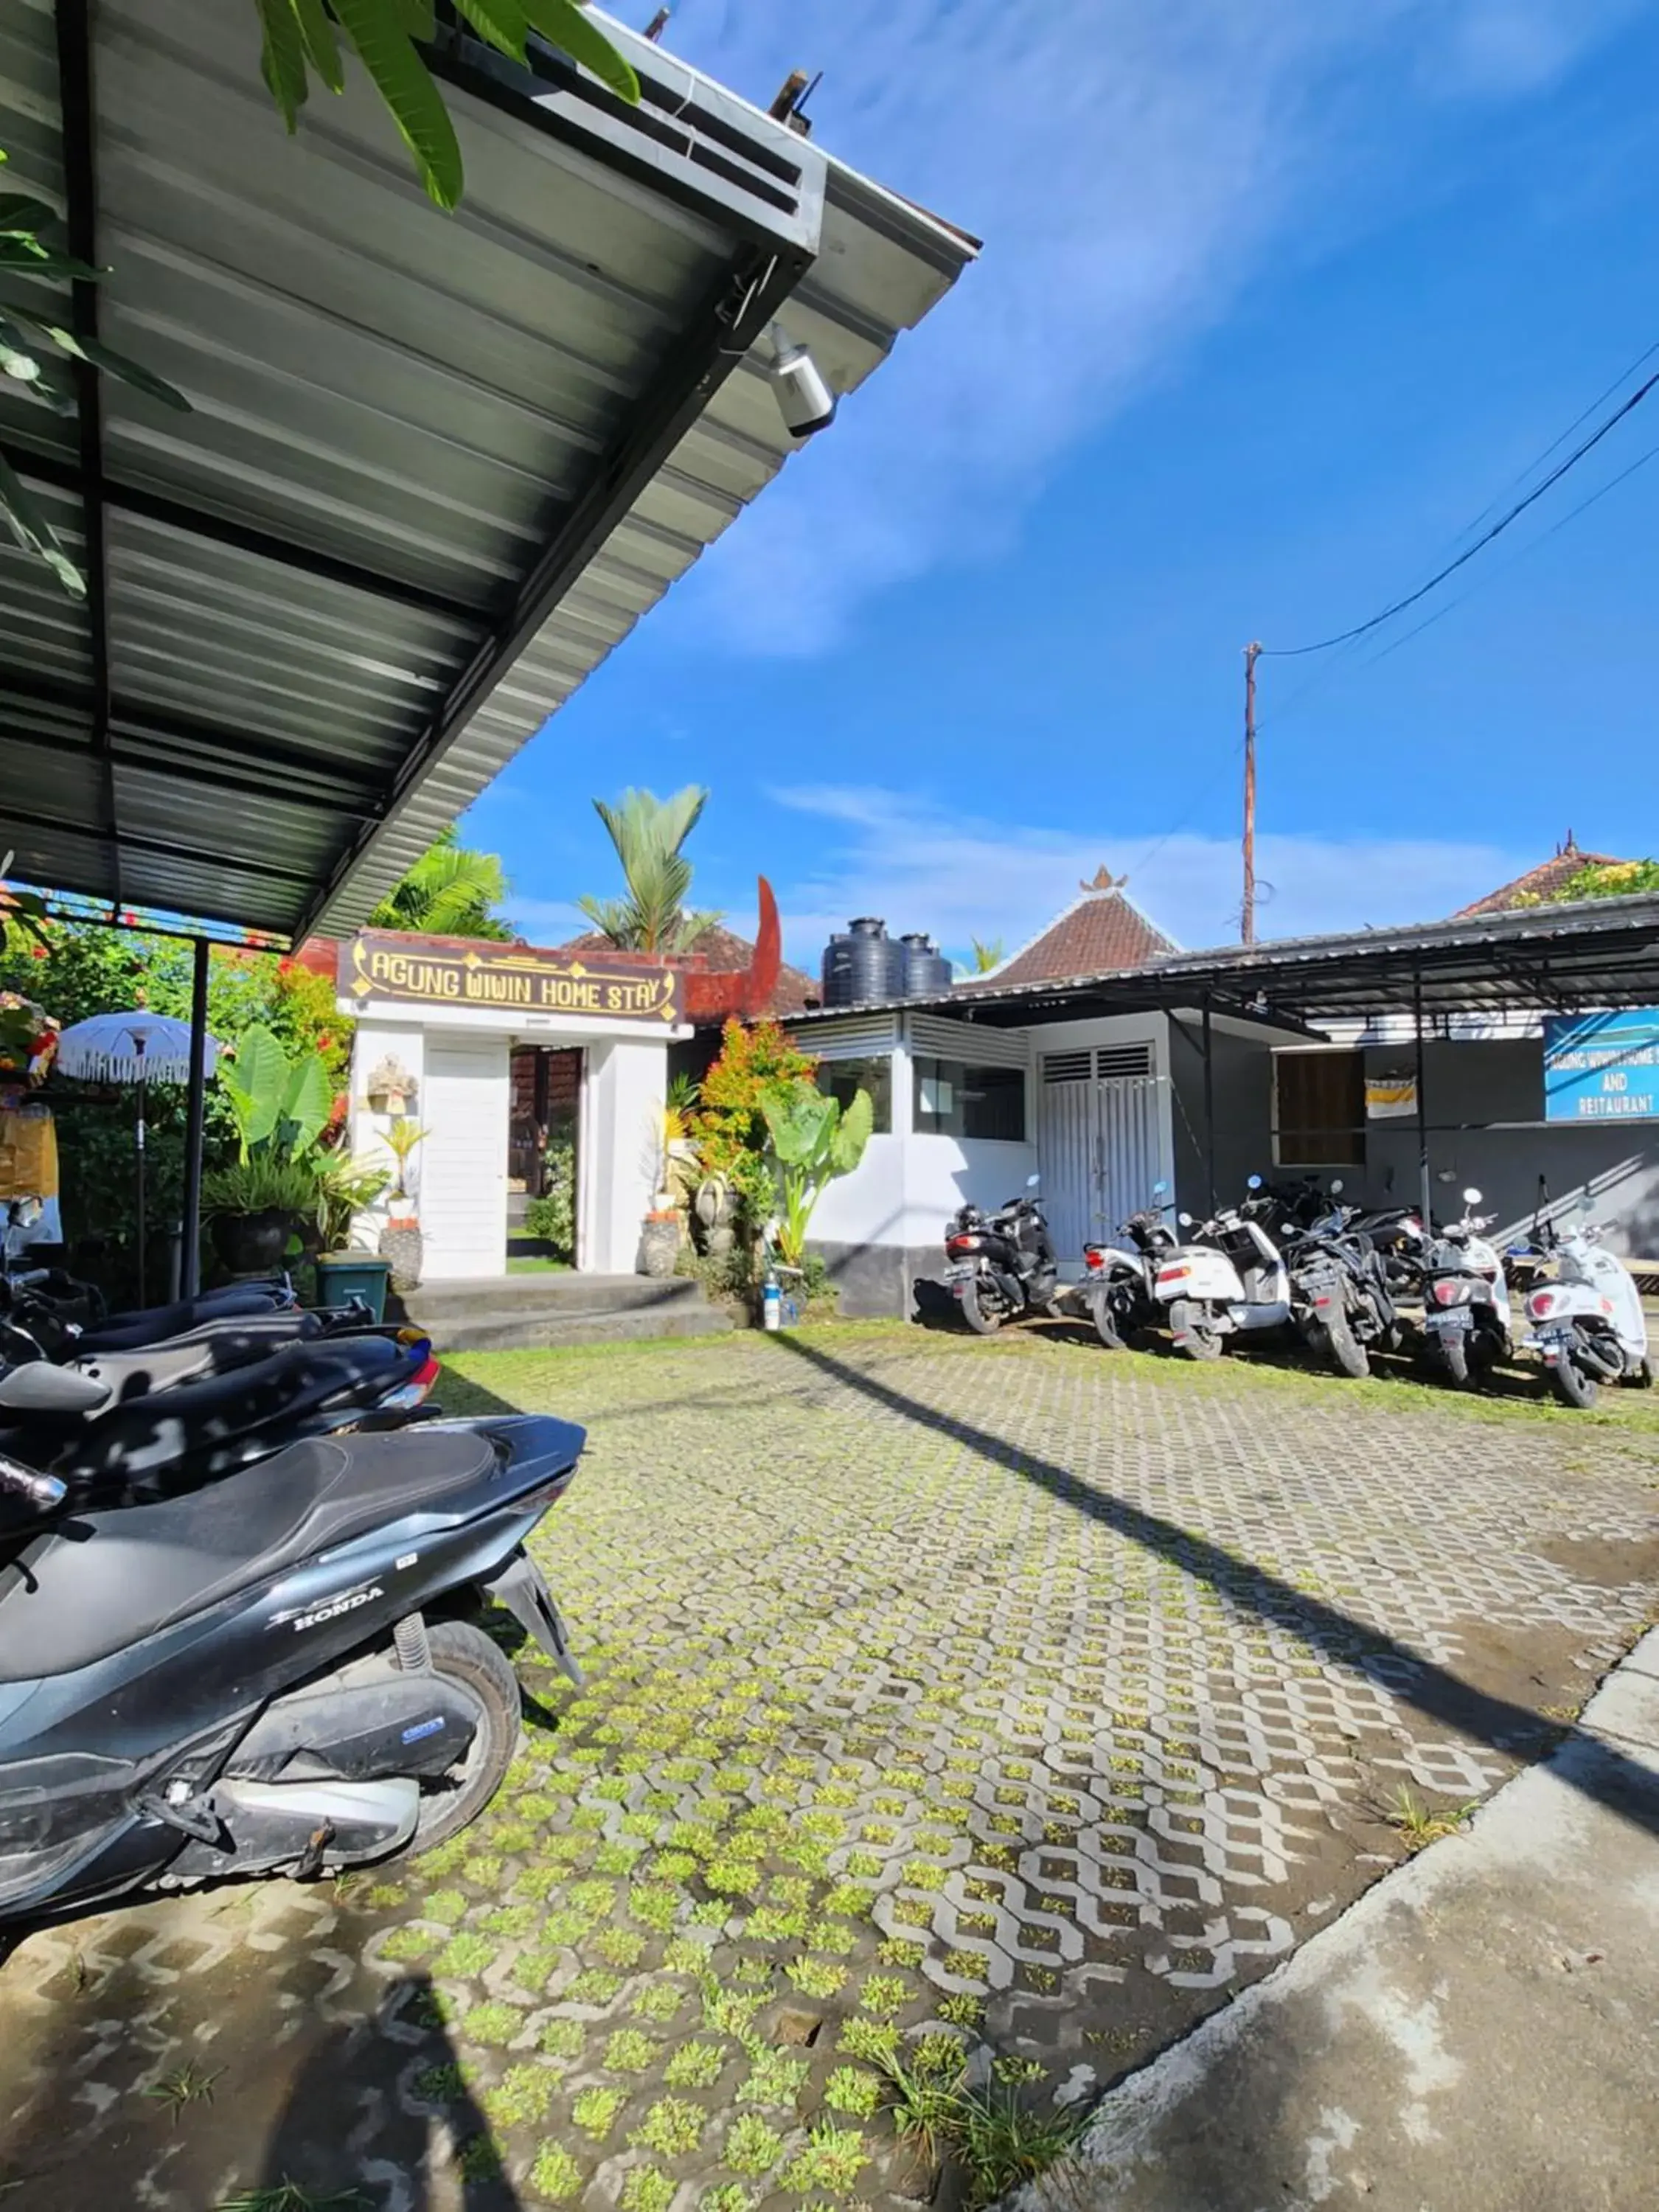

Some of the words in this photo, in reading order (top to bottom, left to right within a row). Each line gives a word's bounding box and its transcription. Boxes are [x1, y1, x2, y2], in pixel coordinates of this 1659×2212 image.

[372, 952, 460, 996] AGUNG
[466, 973, 531, 1003] WIWIN
[541, 978, 602, 1009] HOME
[607, 978, 660, 1009] STAY
[1602, 1072, 1628, 1092] AND
[1579, 1093, 1654, 1115] RESTAURANT
[293, 1587, 385, 1632] HONDA
